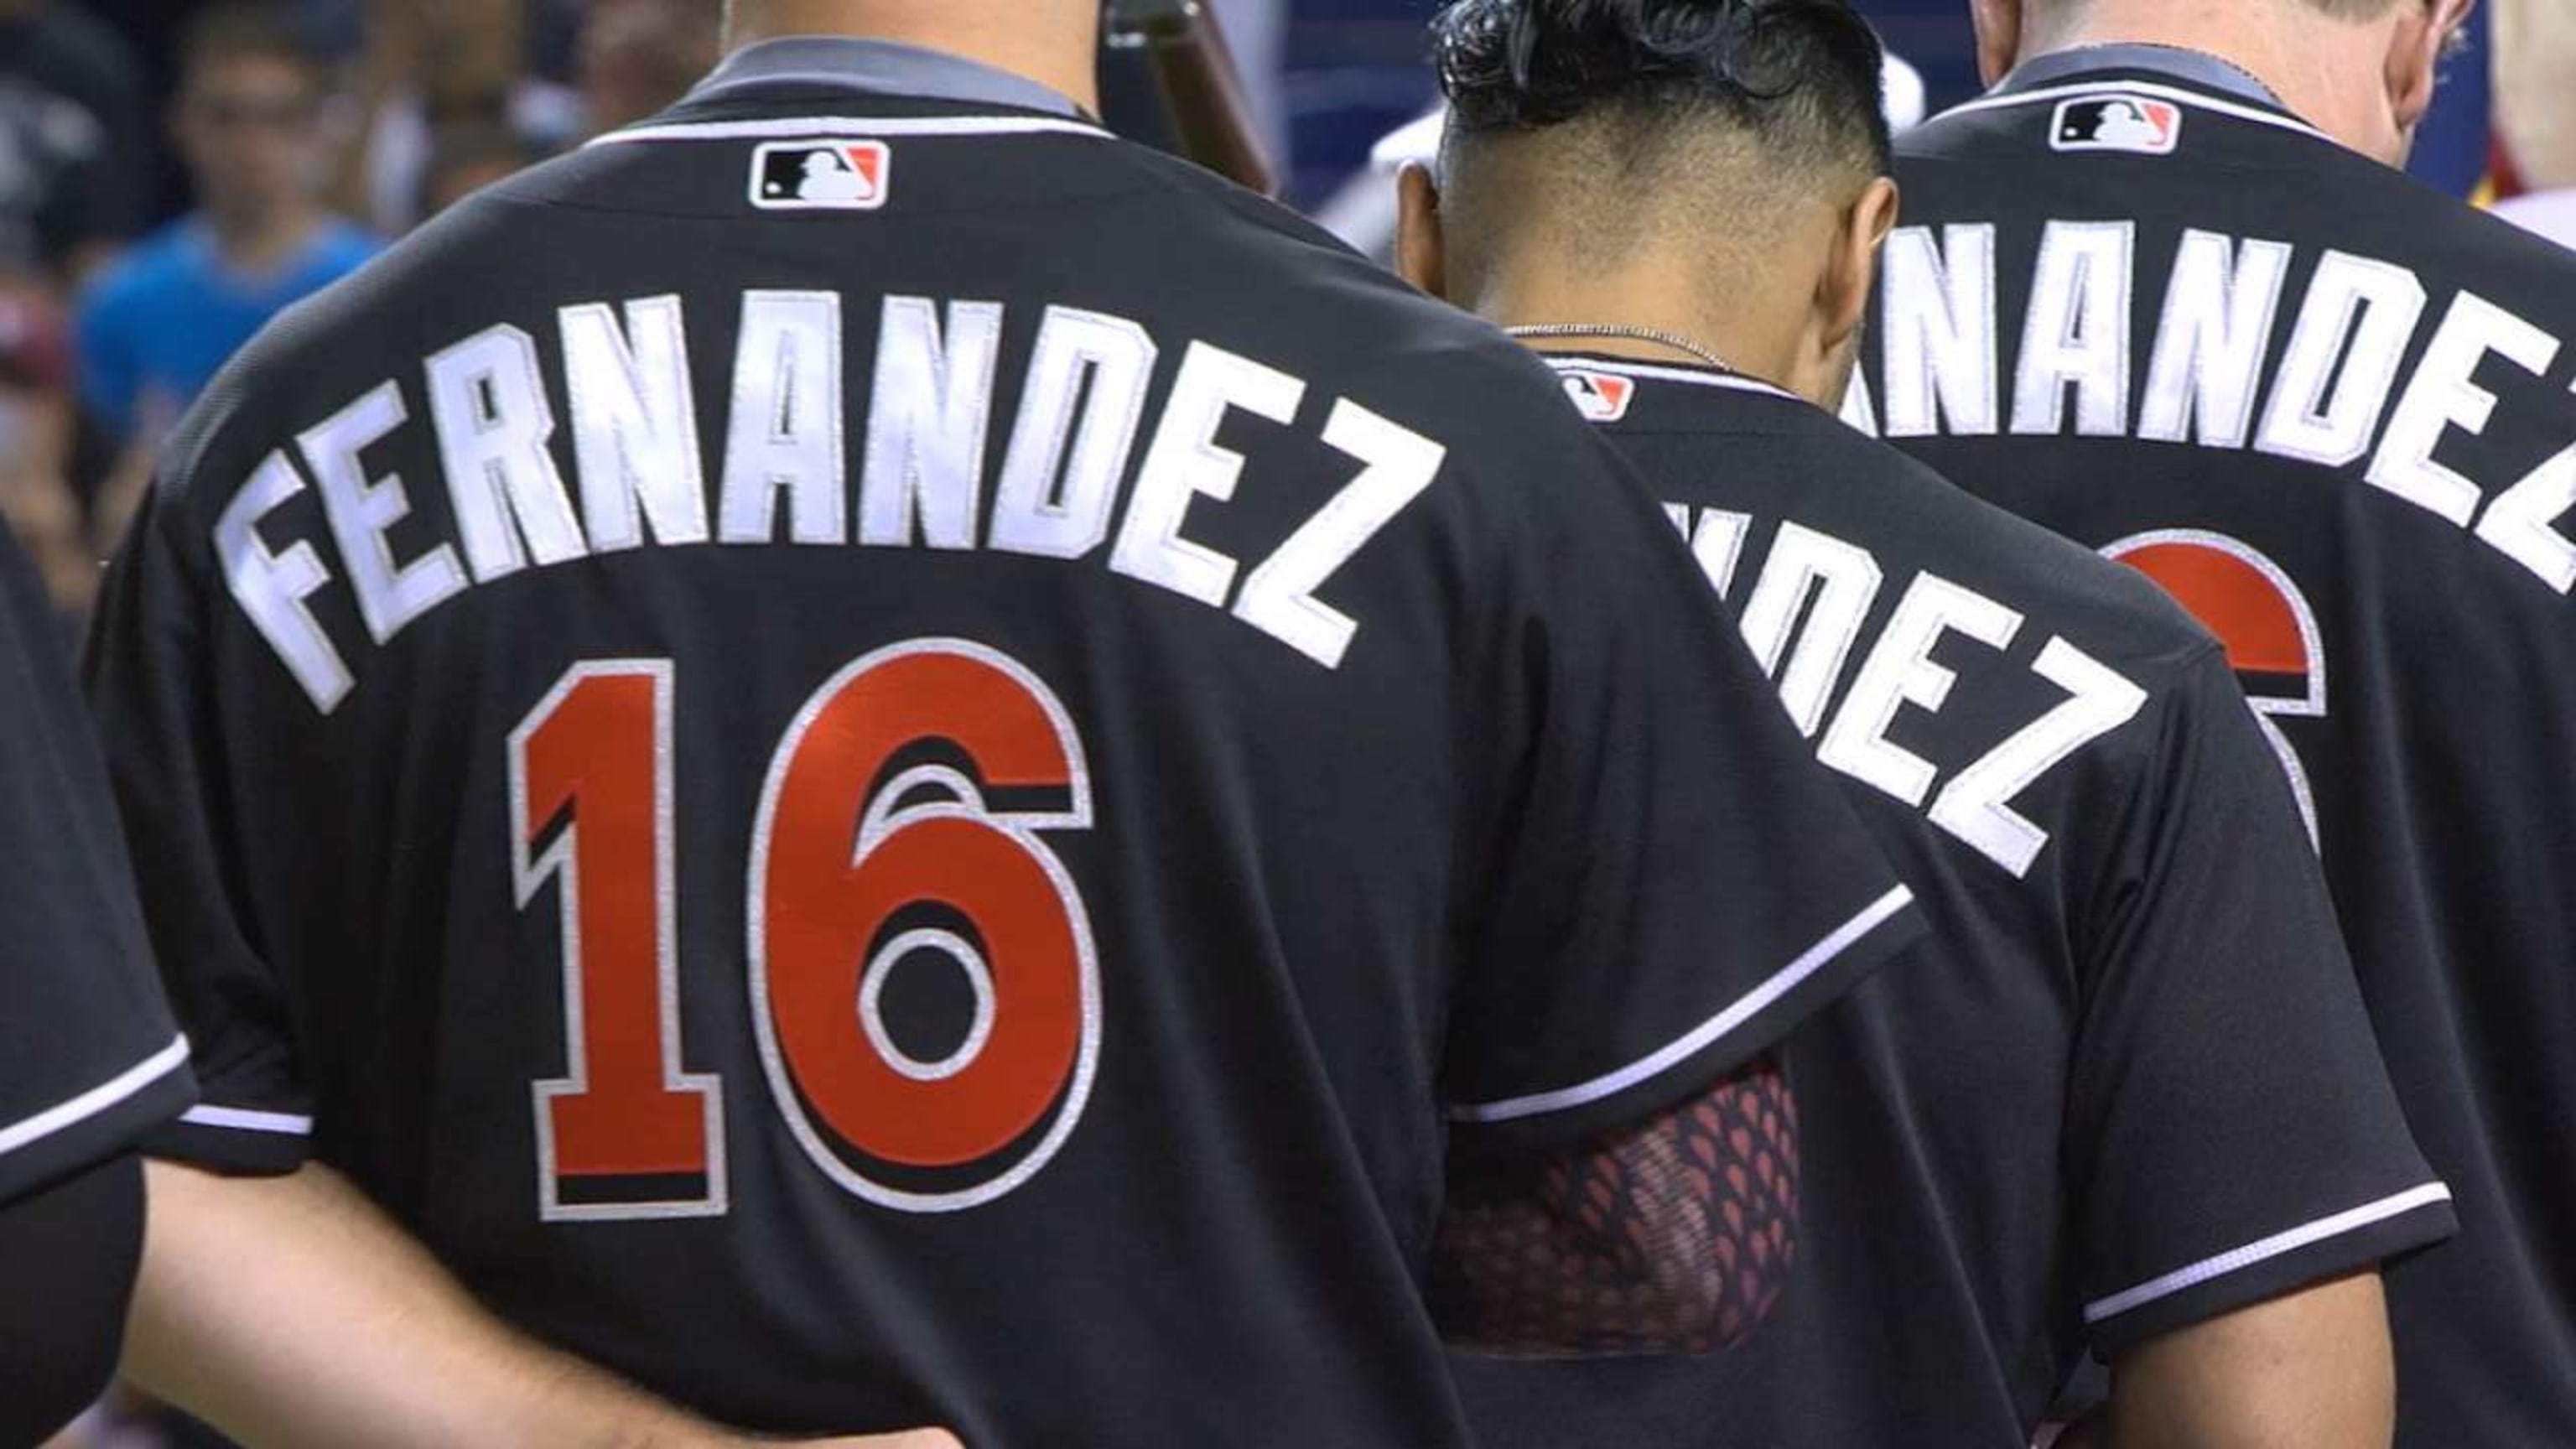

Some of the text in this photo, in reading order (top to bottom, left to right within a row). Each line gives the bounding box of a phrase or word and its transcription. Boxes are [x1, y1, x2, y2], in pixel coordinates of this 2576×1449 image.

[214, 290, 1446, 714] FERNANDEZ
[1838, 220, 2576, 595] NANDE
[506, 637, 1102, 1220] 16
